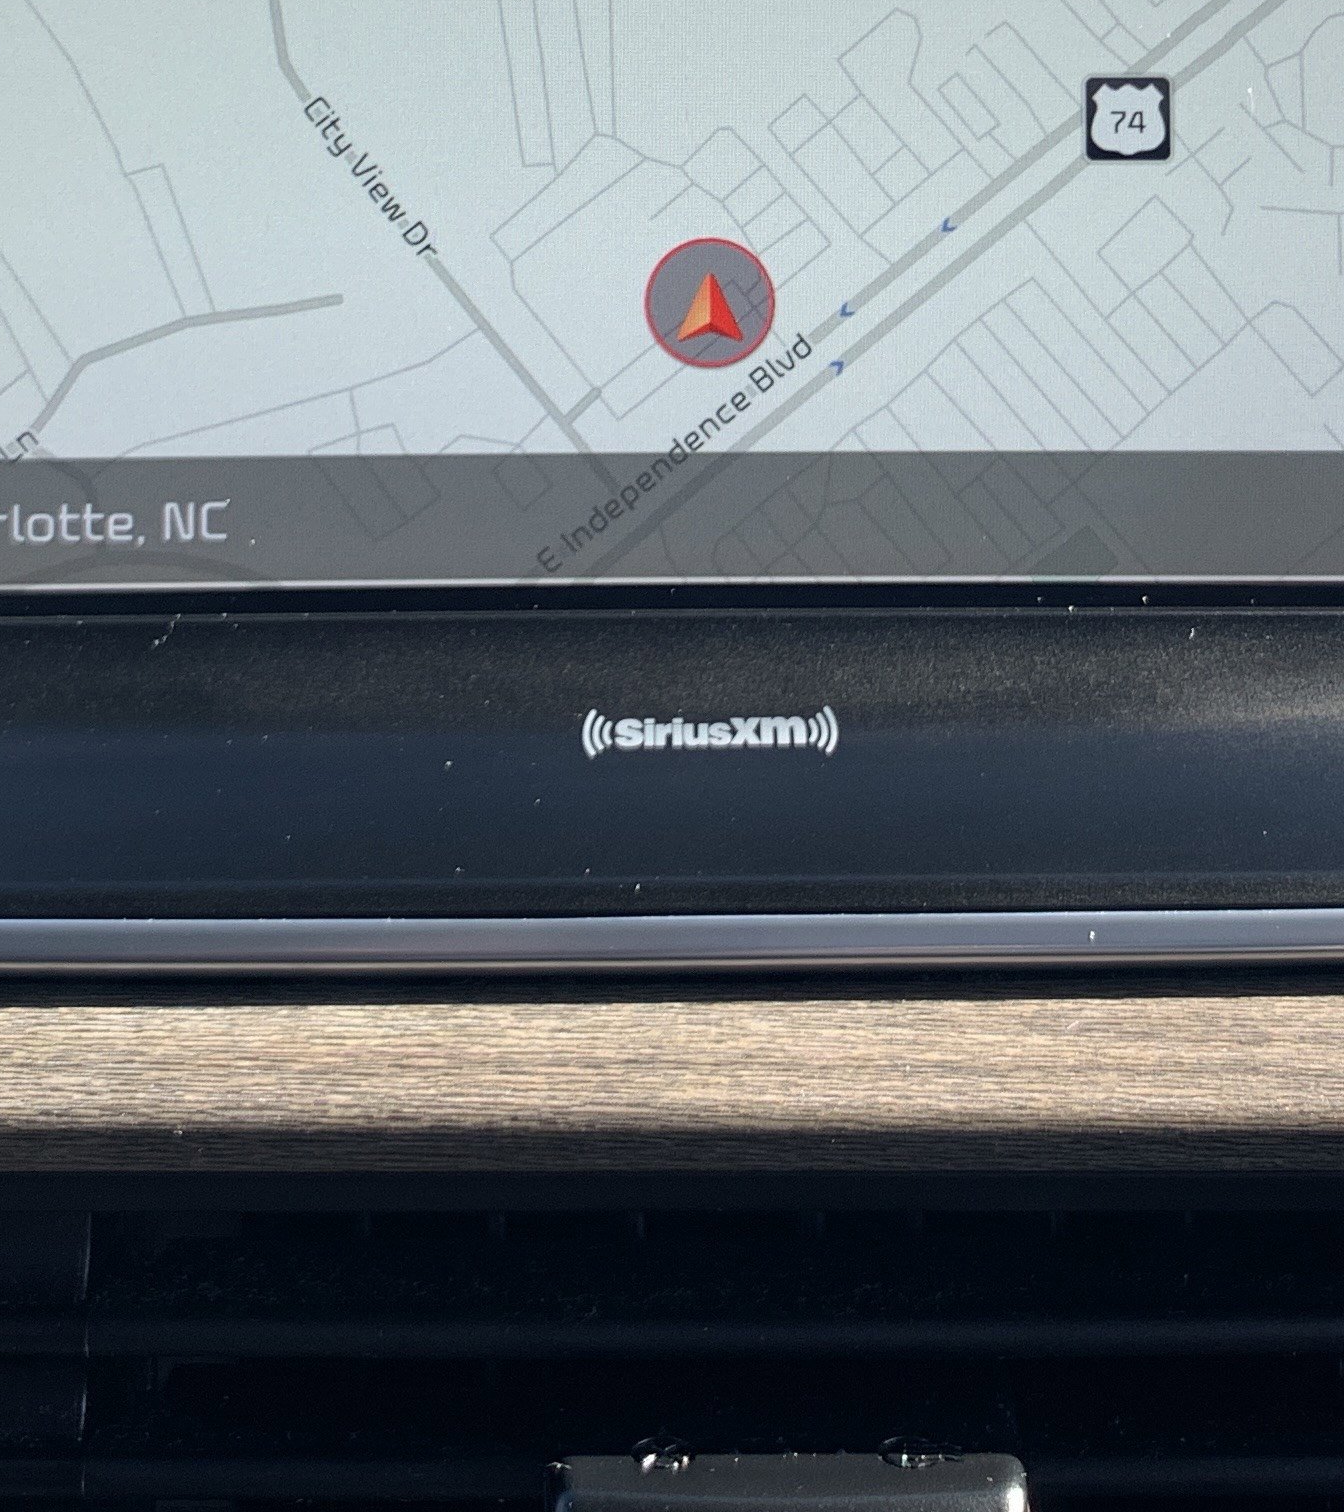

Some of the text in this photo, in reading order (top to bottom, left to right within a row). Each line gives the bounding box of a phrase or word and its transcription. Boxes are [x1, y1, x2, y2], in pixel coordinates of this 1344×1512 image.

[1109, 109, 1147, 136] 74
[303, 95, 439, 259] City View Dr
[536, 333, 814, 575] E Independence Blvd
[162, 500, 232, 543] NC
